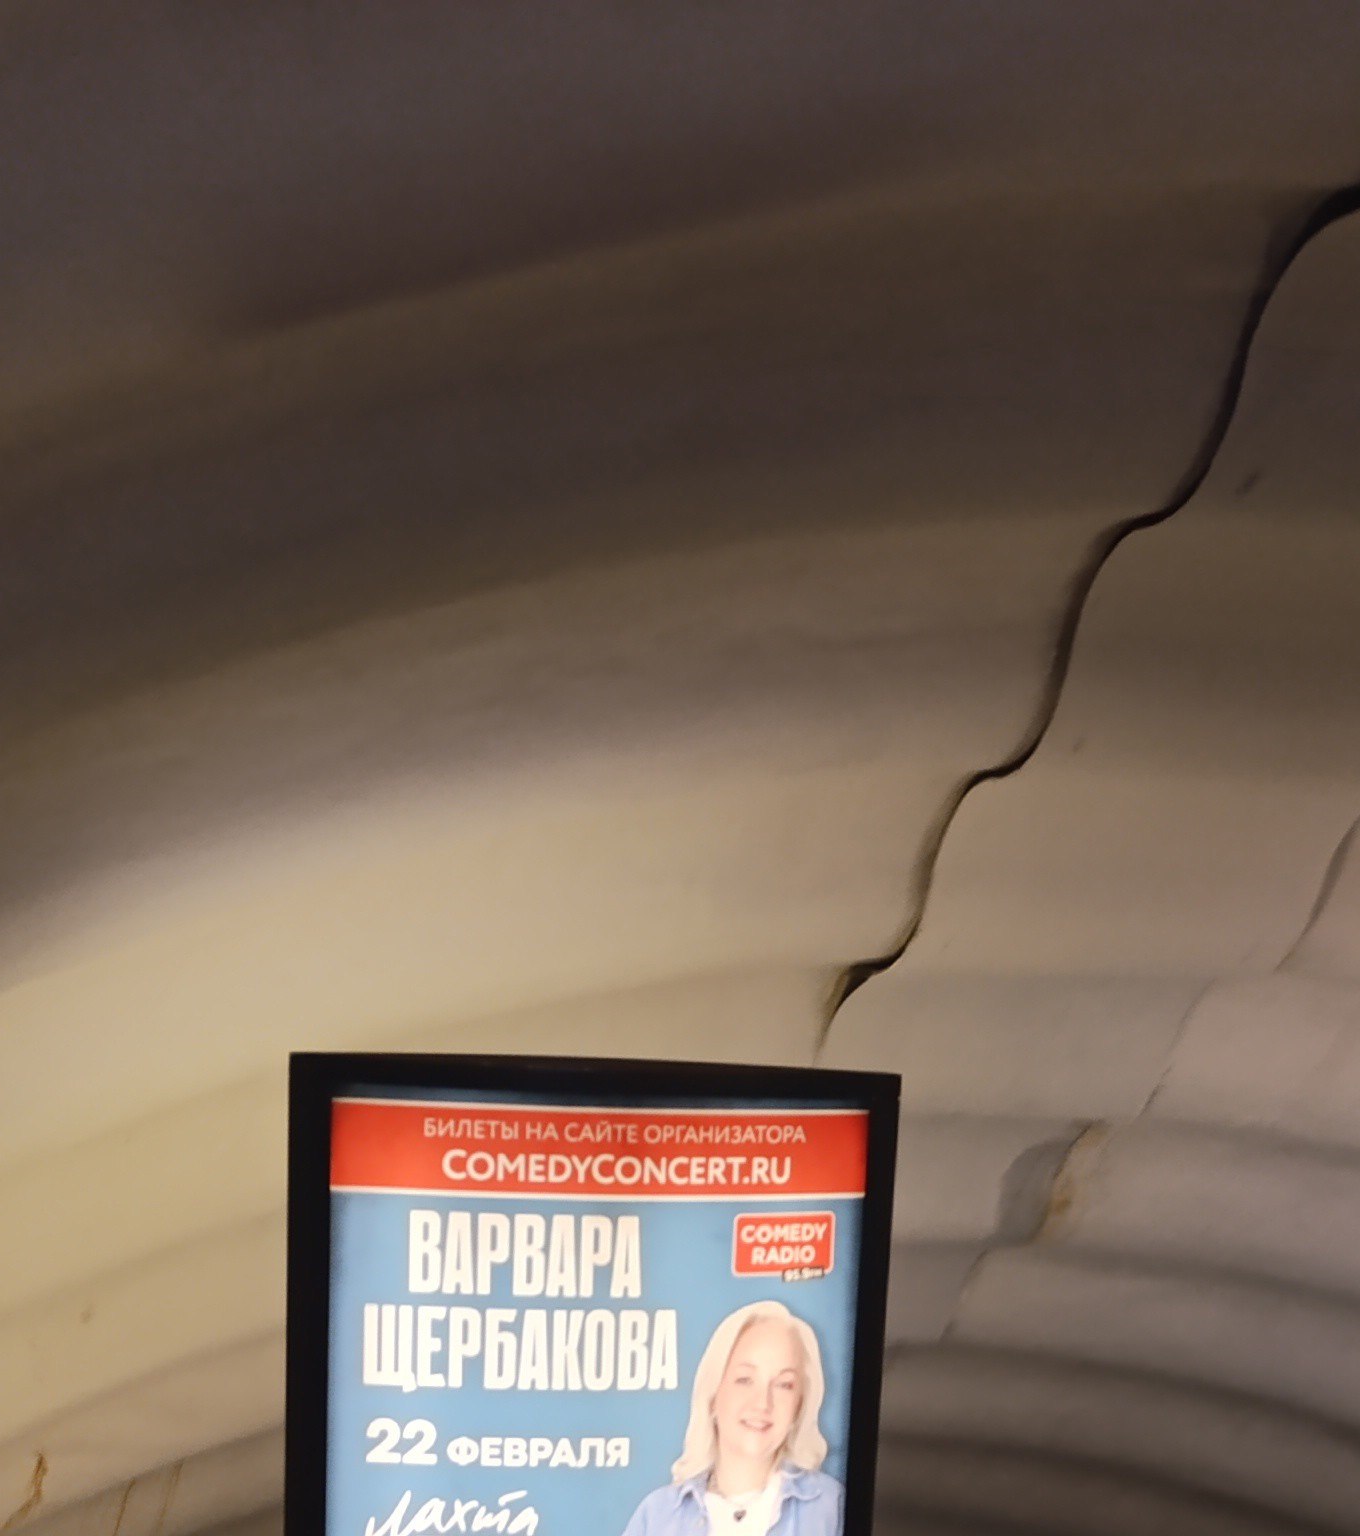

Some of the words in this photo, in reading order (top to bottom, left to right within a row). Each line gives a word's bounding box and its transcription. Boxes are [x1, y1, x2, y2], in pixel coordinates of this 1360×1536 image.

[423, 1117, 520, 1141] БИЛЕТЫ
[525, 1121, 559, 1143] НА
[564, 1116, 639, 1145] САЙТЕ
[643, 1124, 807, 1145] ОРГАНИЗАТОРА
[441, 1148, 792, 1186] COMEDYCONCERT.RU
[740, 1223, 828, 1244] COMEDY
[408, 1209, 642, 1299] ВАРВАРА
[751, 1245, 816, 1265] RADIO
[362, 1303, 679, 1393] ЩЕРБАКОВА
[365, 1418, 438, 1465] 22
[446, 1437, 630, 1468] ФЕВРАЛЯ
